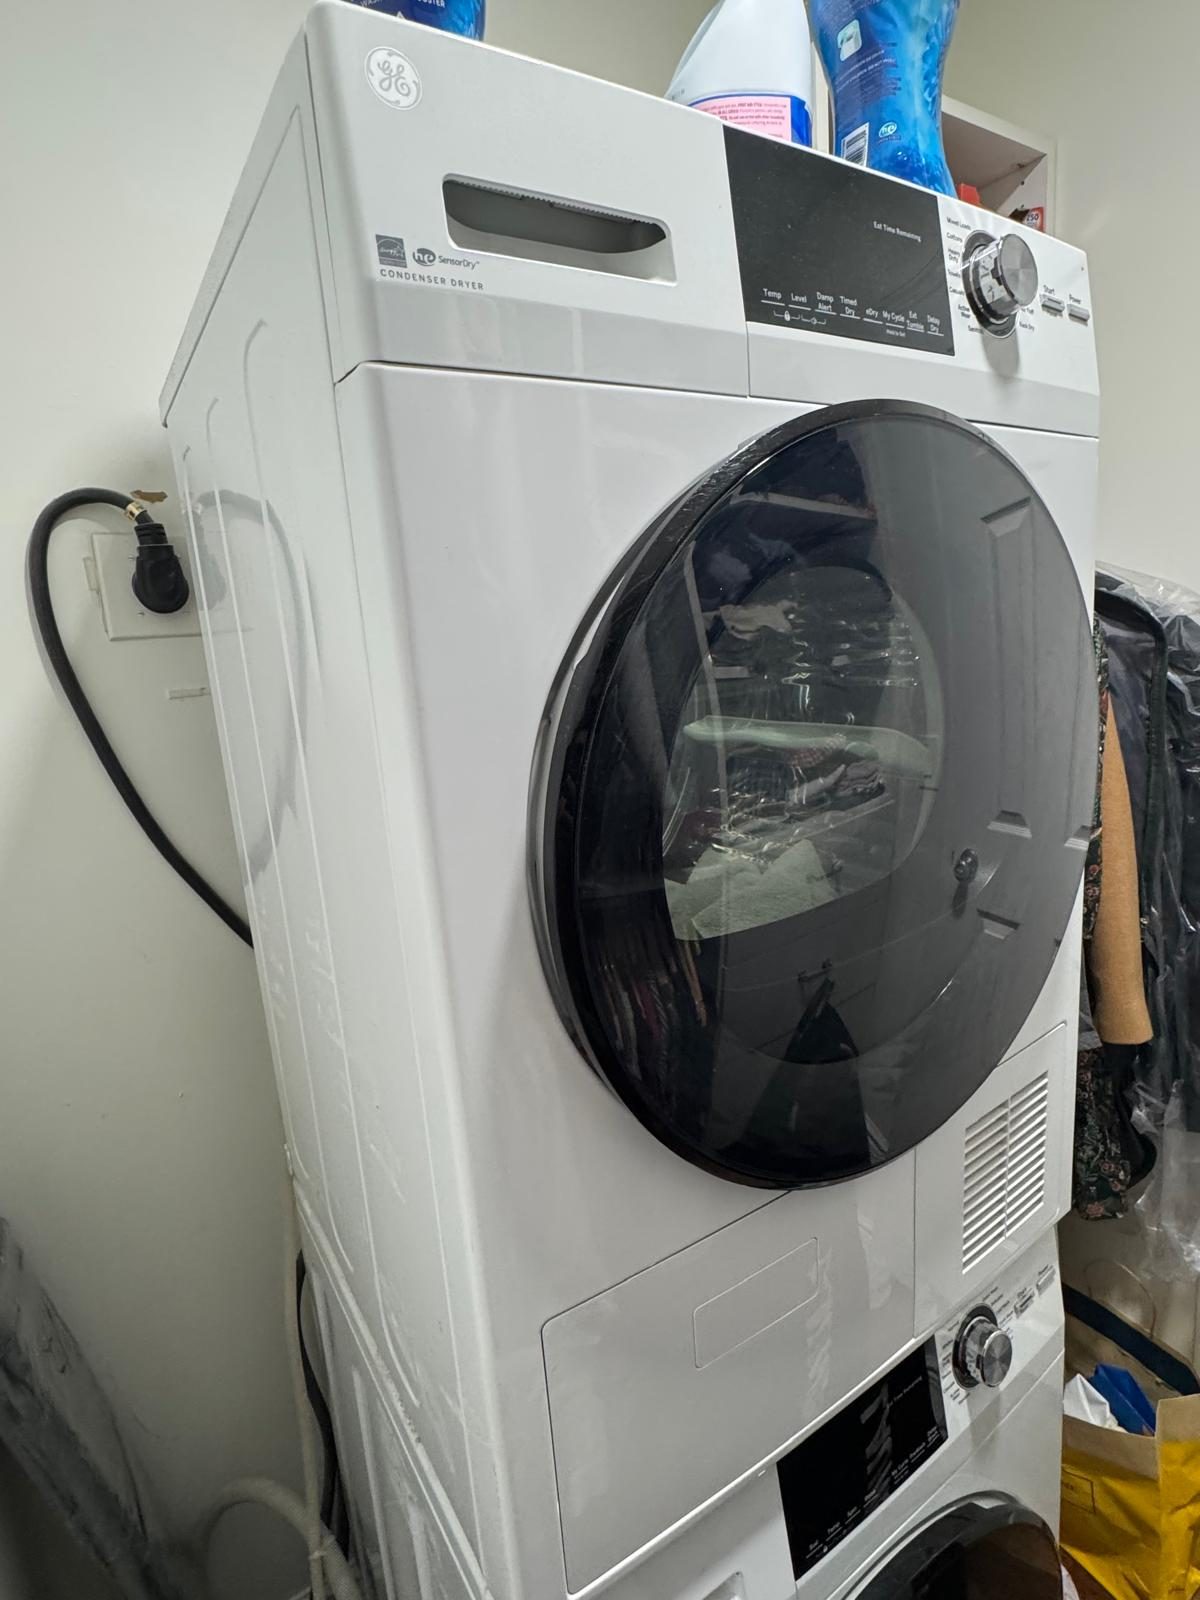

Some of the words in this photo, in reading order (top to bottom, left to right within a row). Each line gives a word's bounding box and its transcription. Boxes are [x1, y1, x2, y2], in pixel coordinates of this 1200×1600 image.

[380, 268, 447, 285] CONDENSER
[450, 278, 485, 291] DRYER
[762, 287, 783, 301] Temp
[790, 292, 808, 304] Level
[816, 291, 835, 304] Damp
[818, 302, 833, 312] Alert
[839, 295, 858, 307] Timed
[845, 306, 856, 317] Dry
